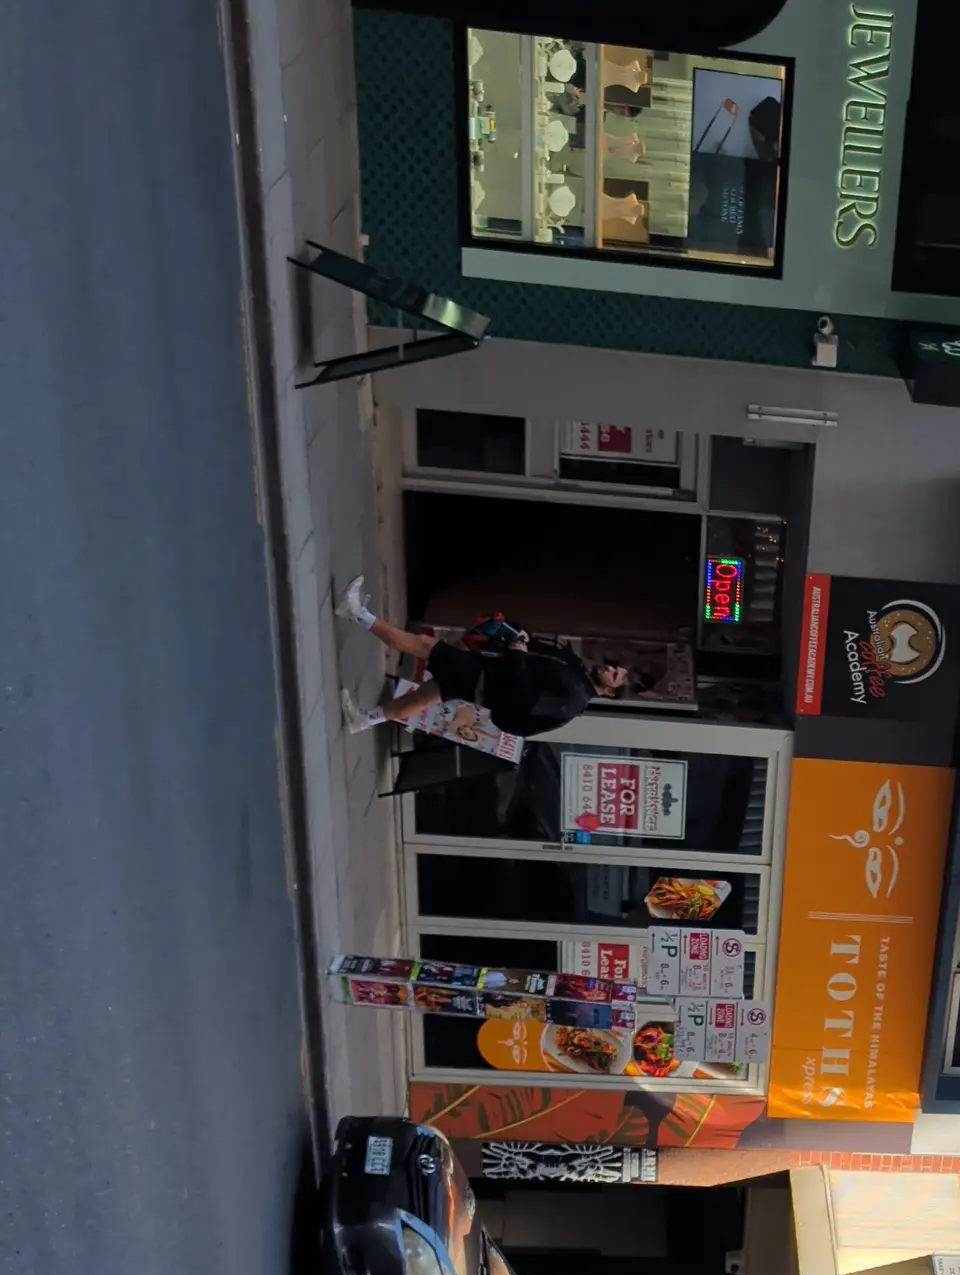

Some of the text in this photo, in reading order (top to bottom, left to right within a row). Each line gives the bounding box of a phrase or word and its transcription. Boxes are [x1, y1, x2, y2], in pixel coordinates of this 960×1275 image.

[833, 3, 894, 249] JEWELLERS
[711, 564, 738, 619] Open
[804, 586, 822, 704] AUSTRALIANCOFFEEACADEMY.COM.AU
[866, 610, 888, 660] Australian
[843, 630, 867, 704] Academy
[582, 764, 594, 792] 8410
[600, 767, 617, 824] LEASE
[619, 778, 636, 816] FOR
[600, 949, 612, 980] Leas
[690, 938, 699, 954] ZONE
[817, 935, 862, 1107] TOTHS
[863, 937, 890, 1109] TASTE OF THE HIMALAYAS
[801, 1056, 817, 1105] xpress
